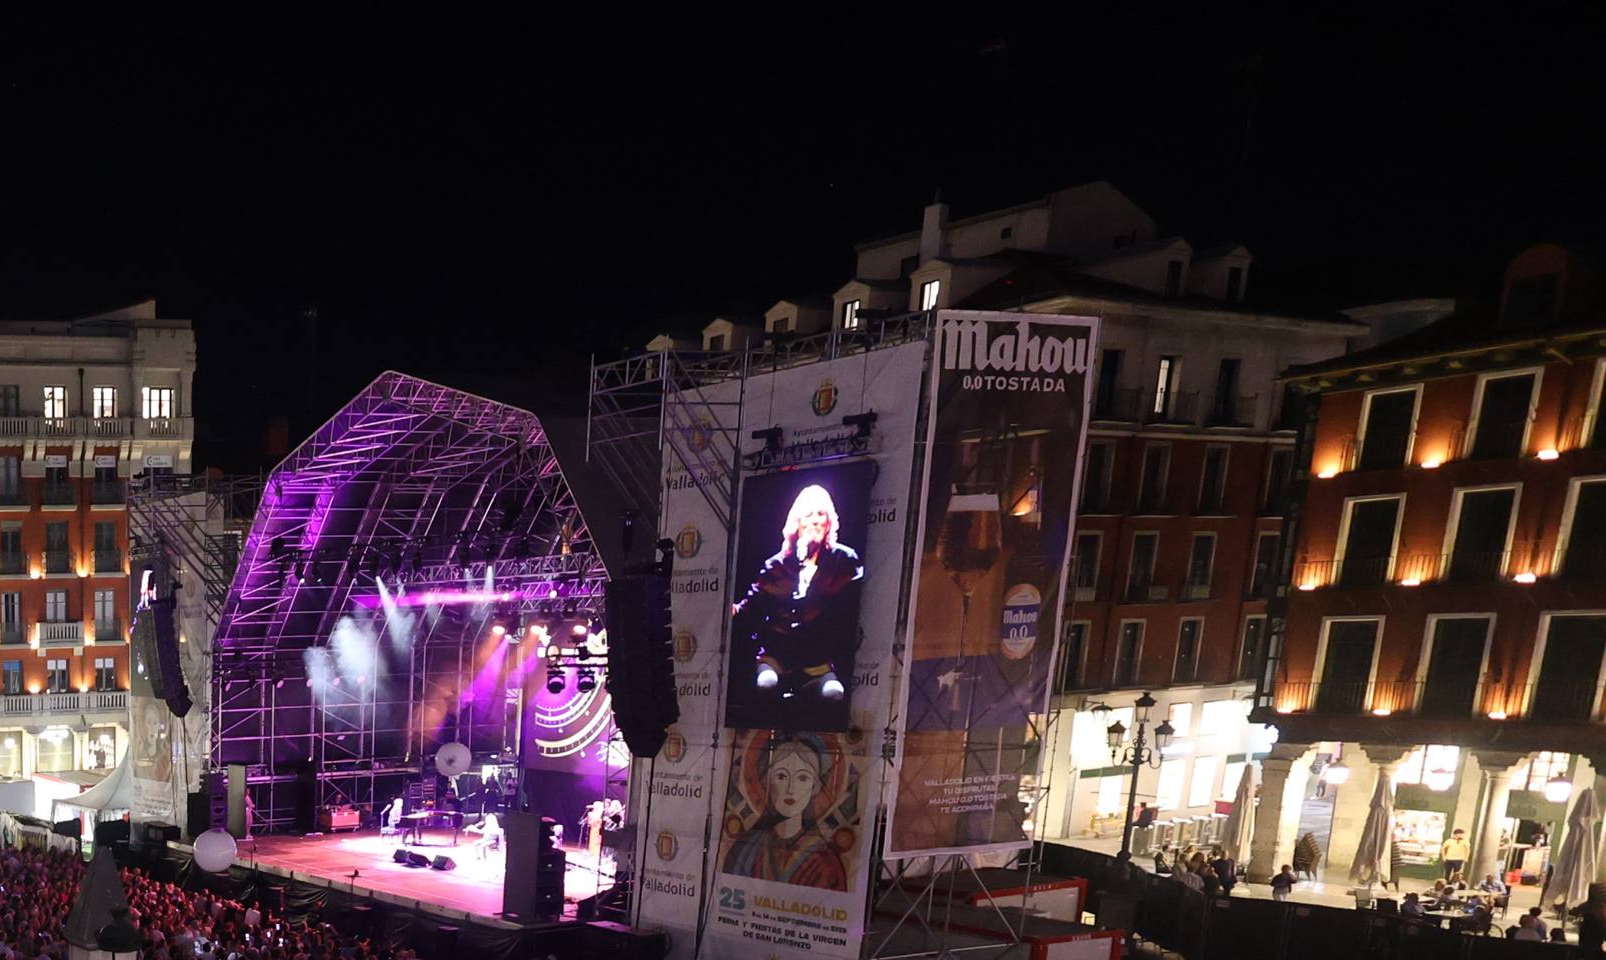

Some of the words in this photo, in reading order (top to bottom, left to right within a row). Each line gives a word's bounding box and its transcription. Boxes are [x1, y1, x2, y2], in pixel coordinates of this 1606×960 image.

[943, 319, 1088, 375] Mahou
[671, 578, 719, 593] lladolid
[1003, 609, 1039, 625] Mahou
[718, 886, 746, 911] 25
[753, 895, 849, 922] VALLADOLID
[717, 915, 740, 927] FERIA
[750, 921, 782, 935] FIESTAS
[785, 929, 796, 939] DE
[799, 931, 810, 941] LA
[812, 935, 847, 947] VIRGEN
[743, 930, 754, 938] DE
[755, 931, 772, 943] SAN
